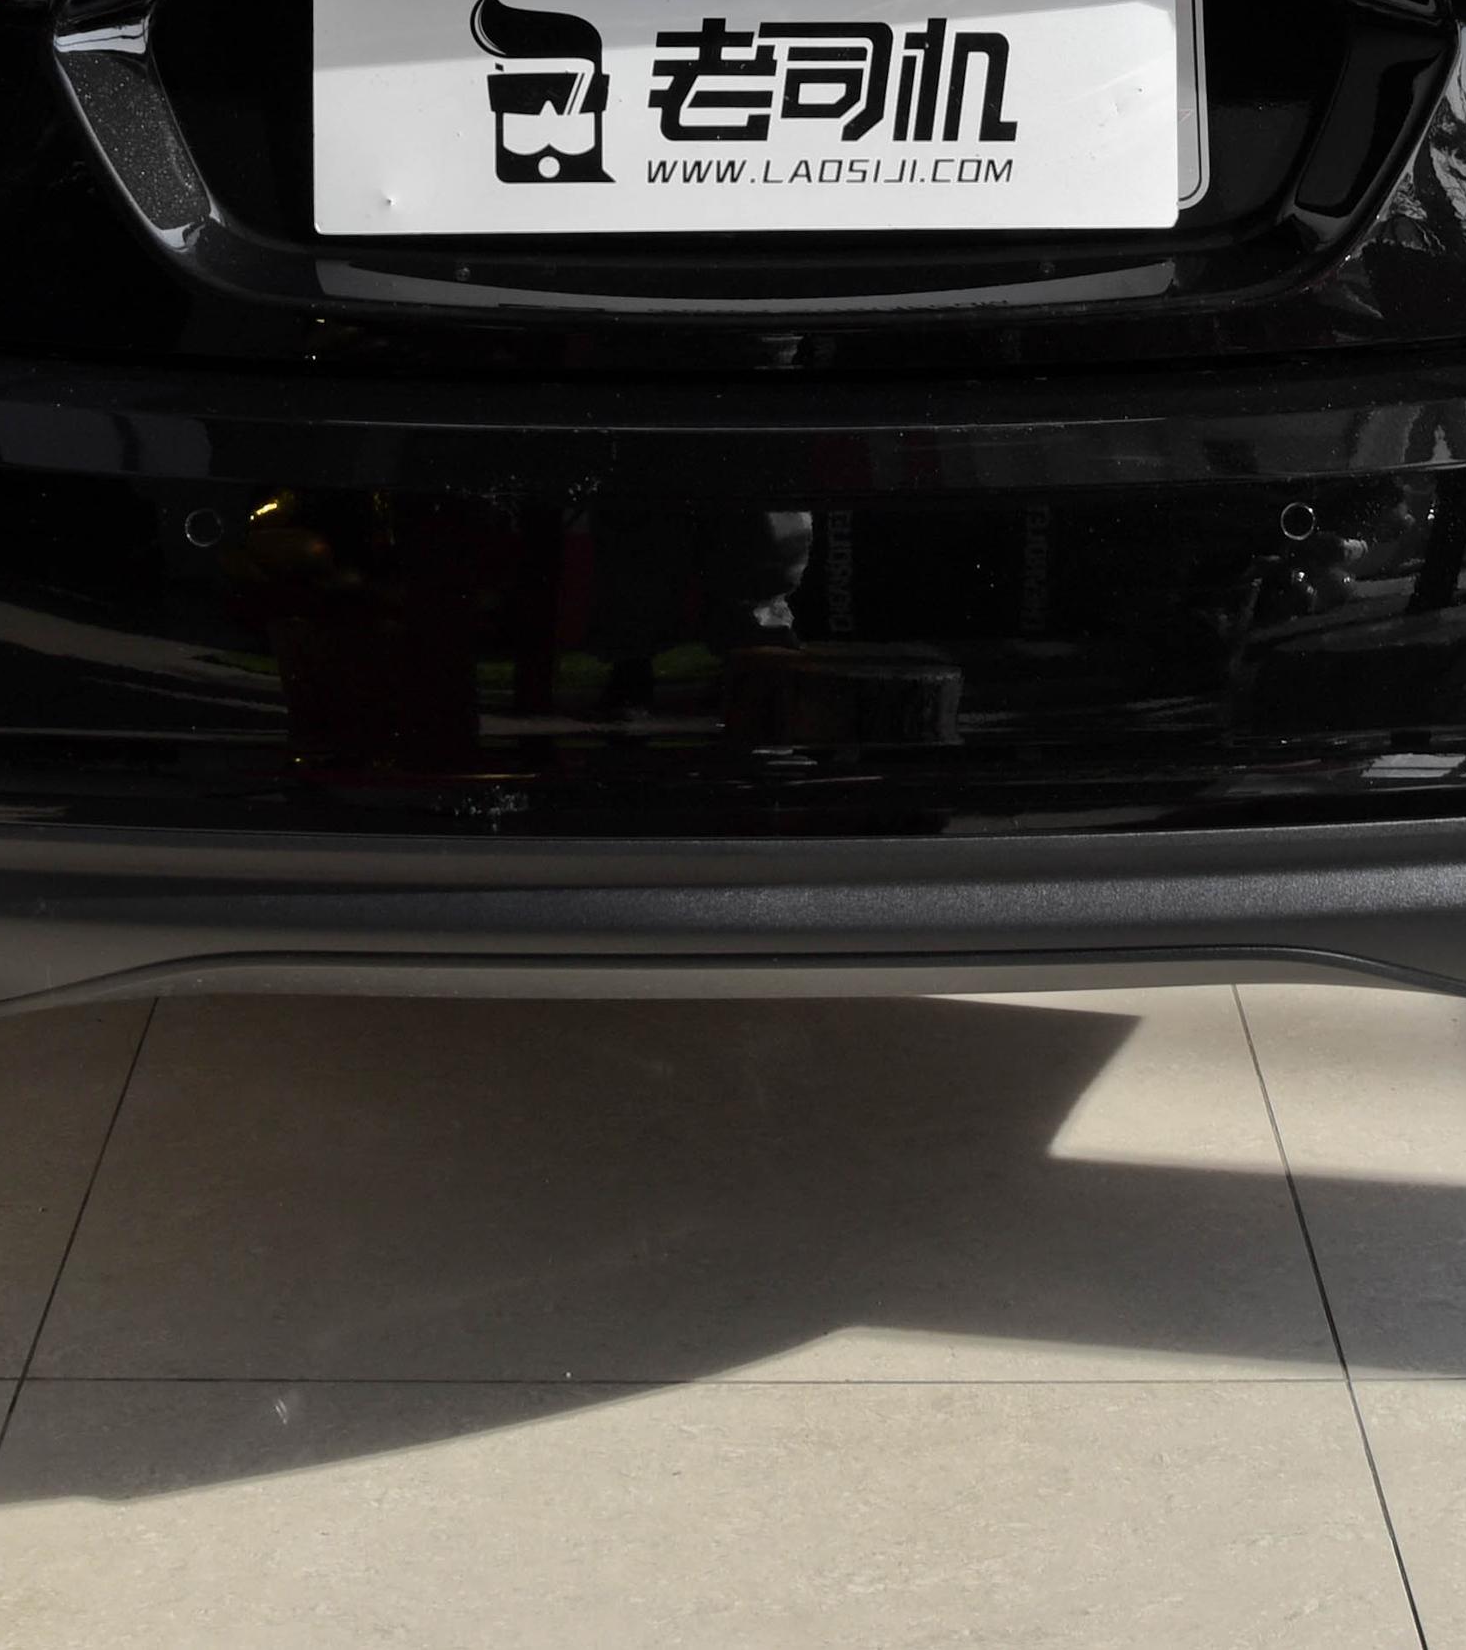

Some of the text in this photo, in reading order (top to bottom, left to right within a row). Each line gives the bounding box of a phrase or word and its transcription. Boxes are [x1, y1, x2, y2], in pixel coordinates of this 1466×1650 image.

[647, 17, 1018, 142] 老司机
[646, 158, 1015, 184] WWW.LAOSIJI.COM
